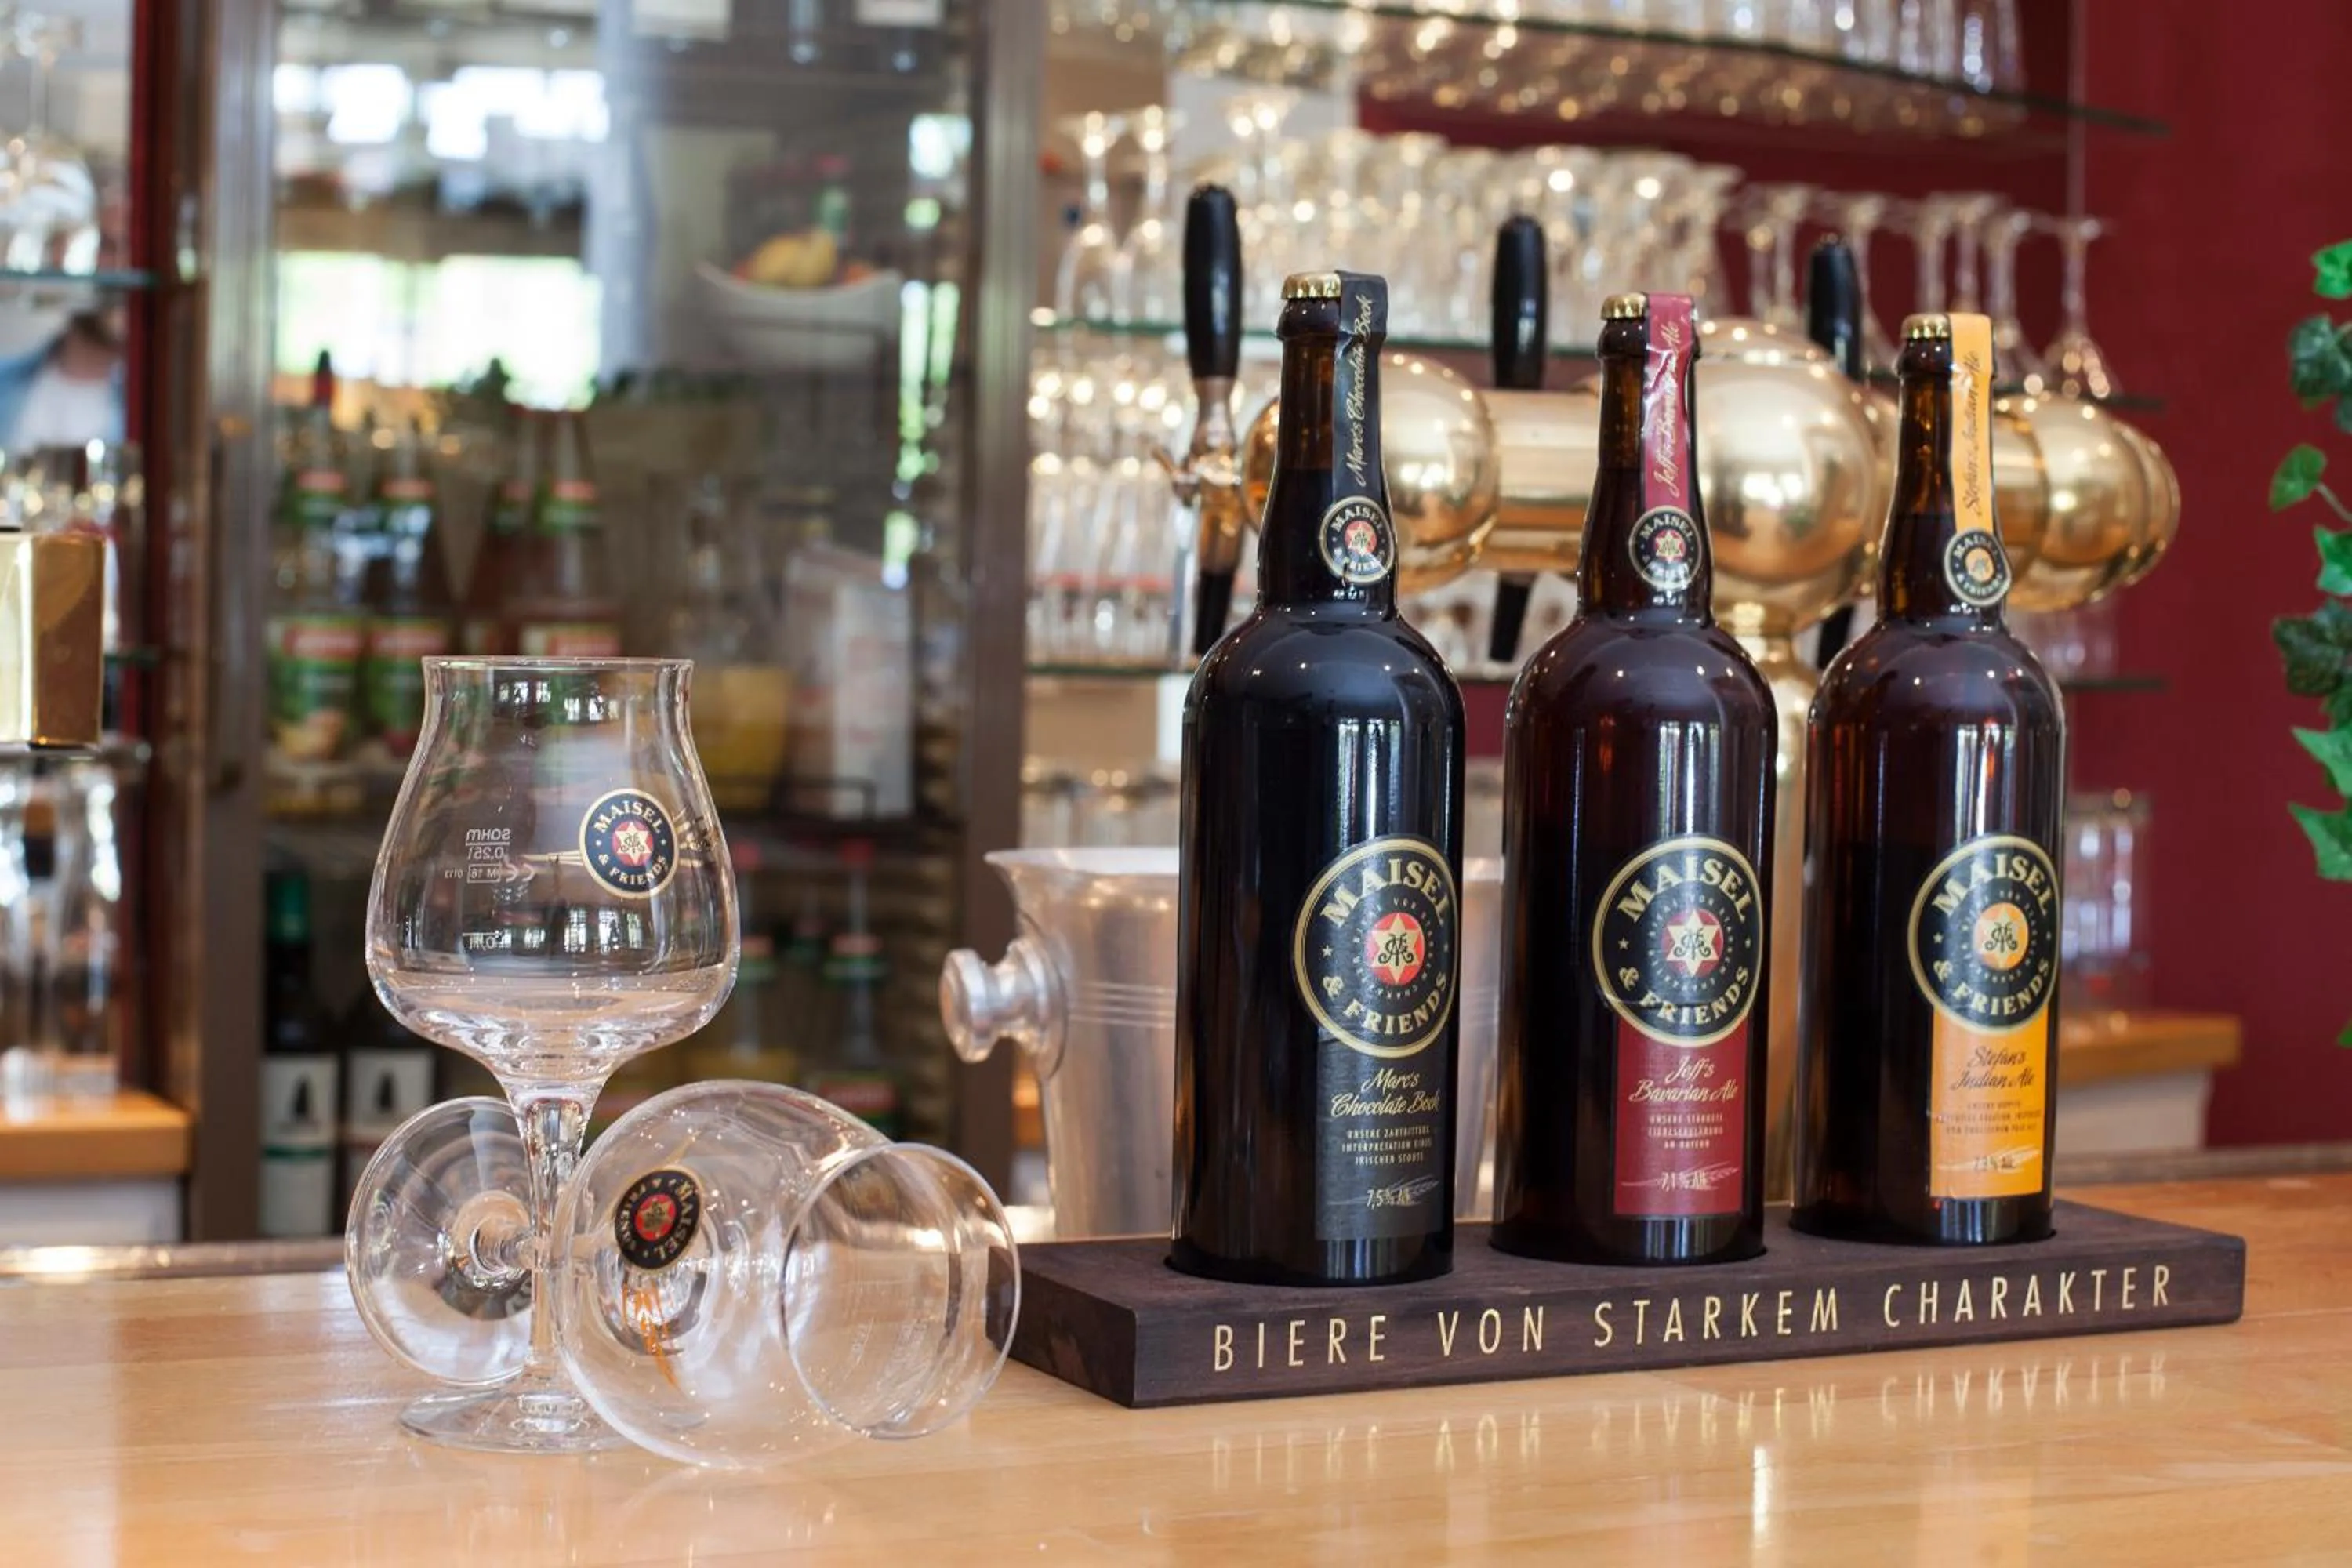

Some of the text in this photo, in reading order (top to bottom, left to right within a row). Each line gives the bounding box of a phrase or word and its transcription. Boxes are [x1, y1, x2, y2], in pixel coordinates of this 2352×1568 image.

[593, 800, 663, 833] MAISEL
[609, 855, 666, 885] FRIENDS
[1321, 858, 1450, 926] MAISEL
[1617, 855, 1753, 923] MAISEL
[1932, 854, 2053, 916] MAISEL
[1343, 972, 1446, 1034] FRIENDS
[1639, 966, 1748, 1025] FRIENDS
[1952, 958, 2049, 1016] FRIENDS
[1331, 1093, 1408, 1118] Chocolate
[1361, 1068, 1421, 1094] Marc's
[1628, 1079, 1709, 1102] Bavarian
[1214, 1265, 2170, 1371] BIERE VON STARKEM CHARAKTER
